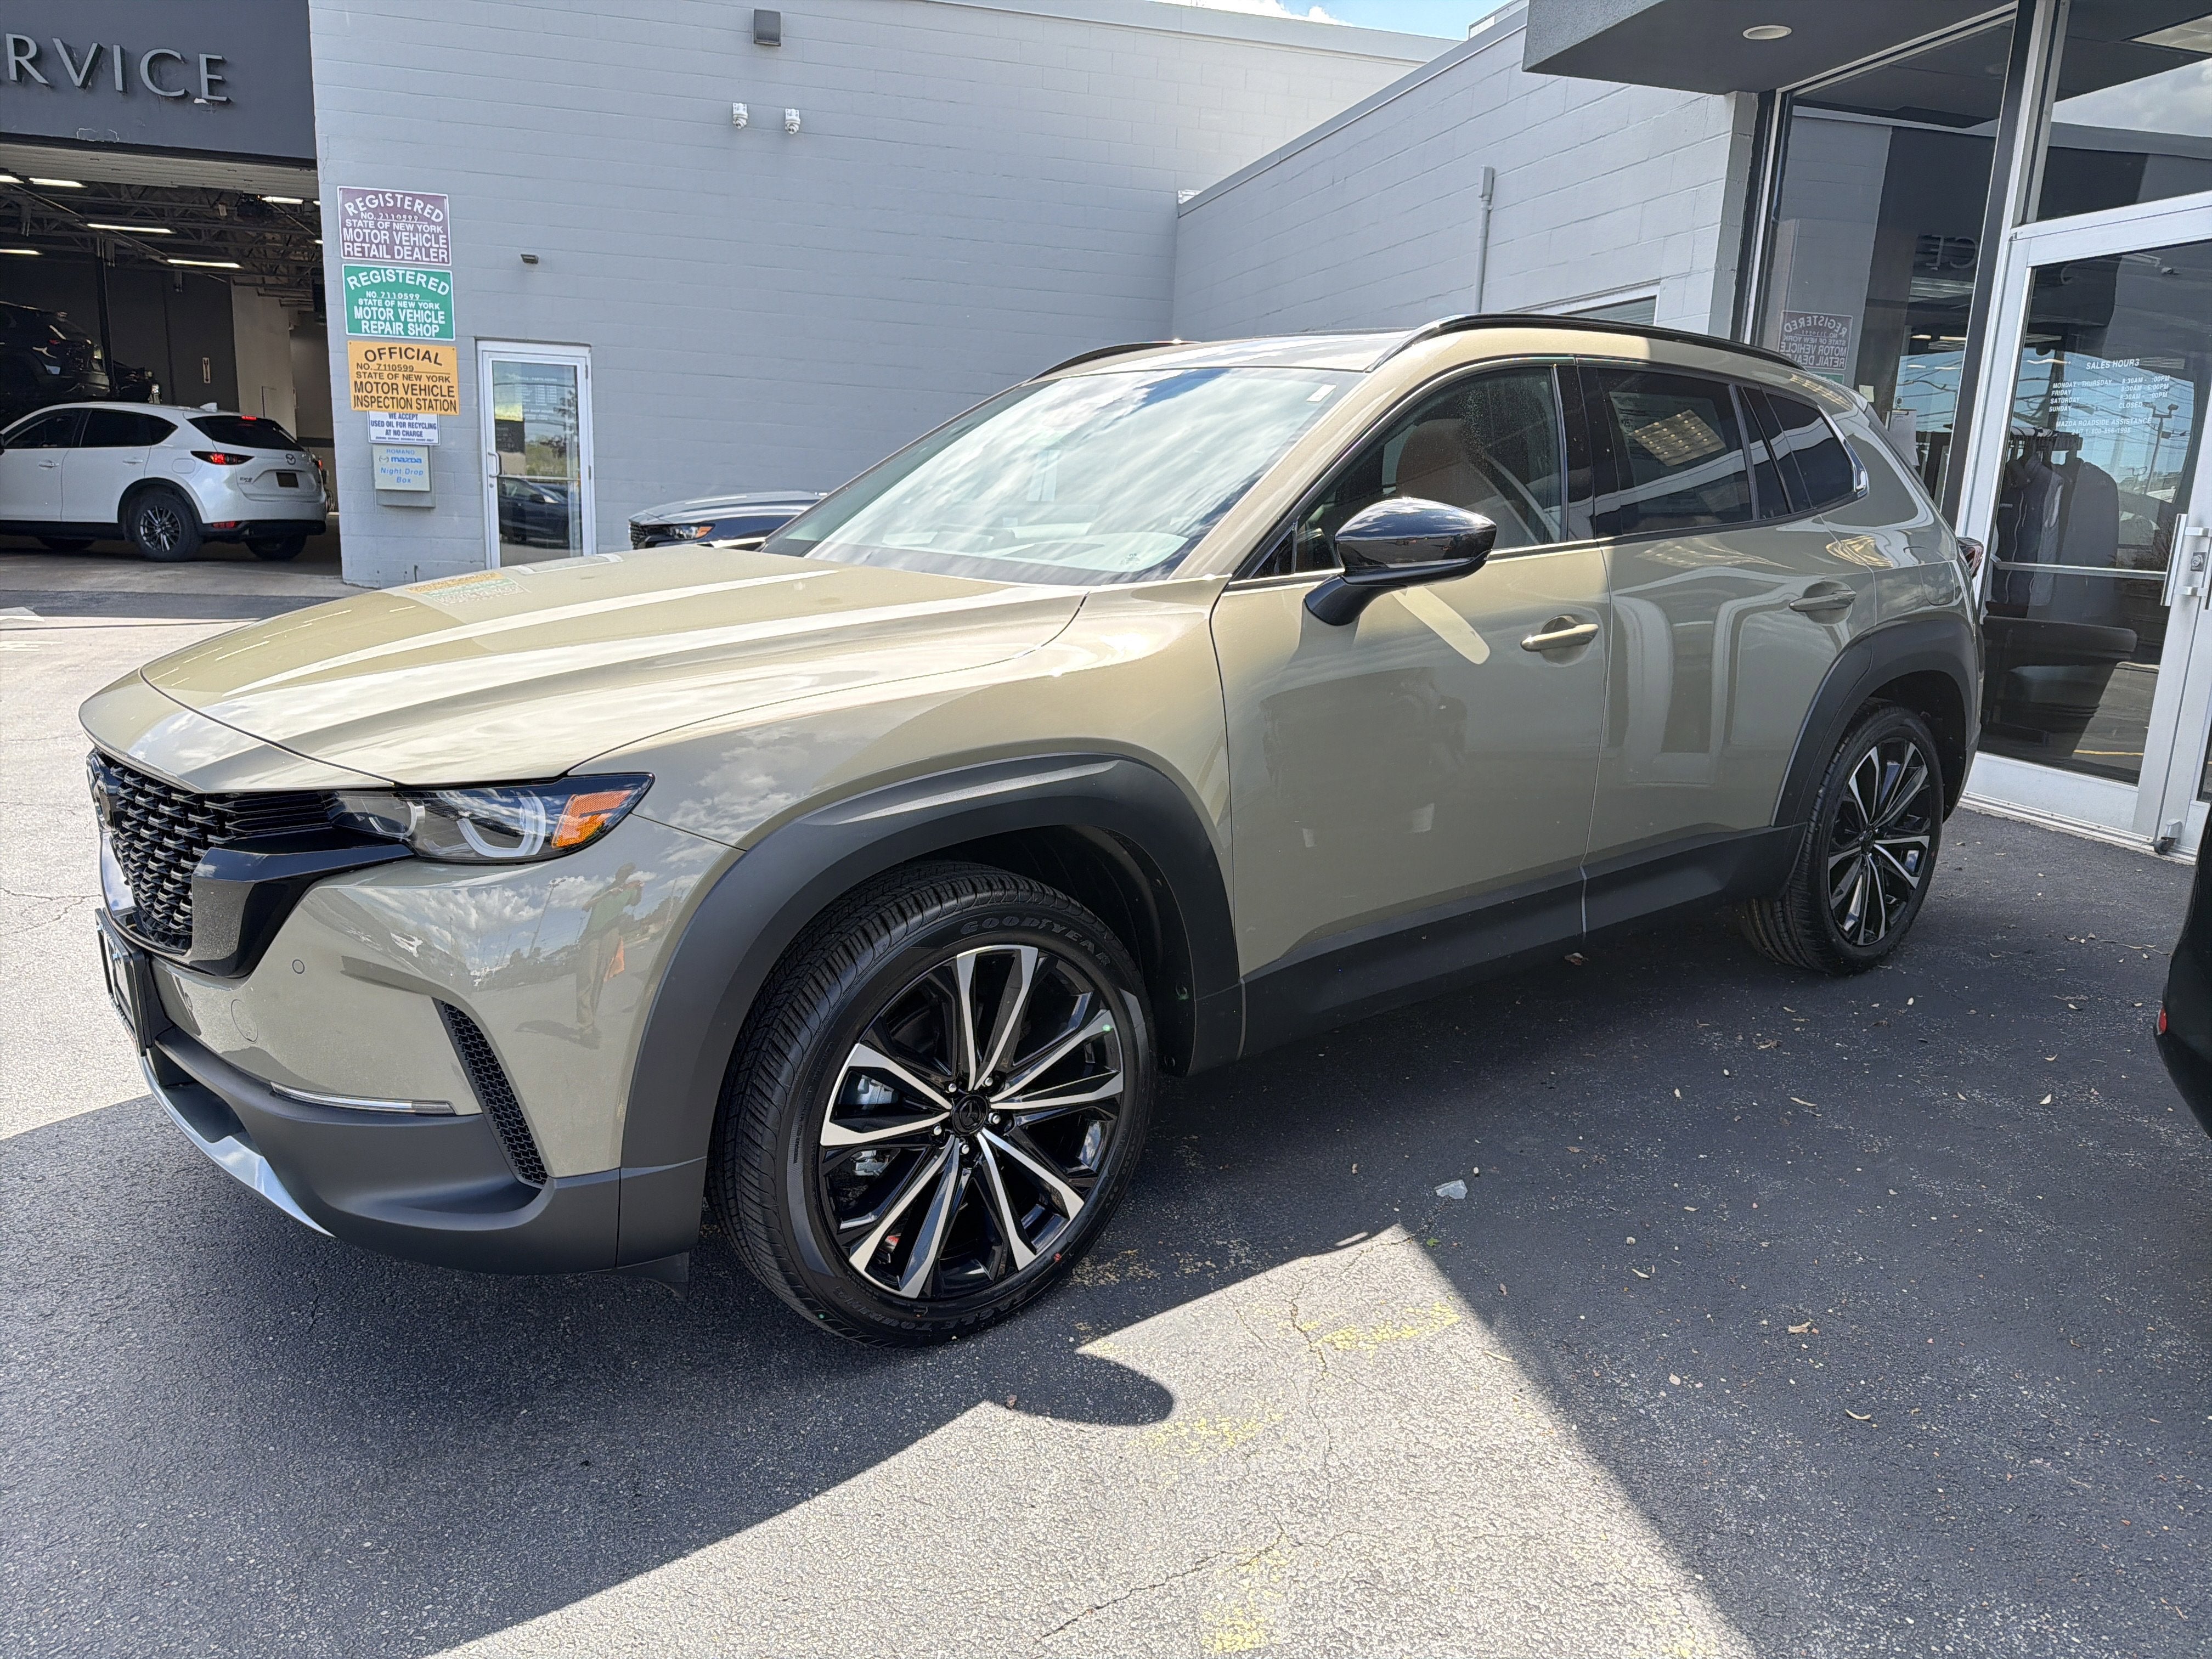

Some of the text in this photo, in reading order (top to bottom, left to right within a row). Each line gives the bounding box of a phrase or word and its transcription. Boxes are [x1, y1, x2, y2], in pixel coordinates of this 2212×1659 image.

[5, 33, 230, 103] RVICE
[344, 193, 443, 223] REGISTERED
[346, 219, 443, 233] STATE OF NEW YORK
[378, 213, 419, 222] 7110599
[343, 227, 447, 248] MOTOR VEHICLE
[344, 242, 448, 263] RETAIL DEALER
[347, 269, 449, 295] REGISTERED
[358, 298, 440, 310] STATE OF NEW YORK
[380, 291, 420, 300] 7110599
[354, 306, 445, 324] MOTOR VEHICLE
[361, 320, 439, 337] REPAIR SHOP
[364, 346, 443, 366] OFFICIAL
[2086, 358, 2140, 370] SALES HOURS
[376, 364, 414, 372] 7110599
[356, 371, 451, 383] STATE OF NEW YORK
[354, 381, 455, 398] MOTOR VEHICLE
[353, 394, 458, 414] INSPECTION STATION
[2112, 417, 2152, 425] ASSISTANCE
[381, 467, 402, 475] Night
[960, 916, 1110, 966] GOODYEAR
